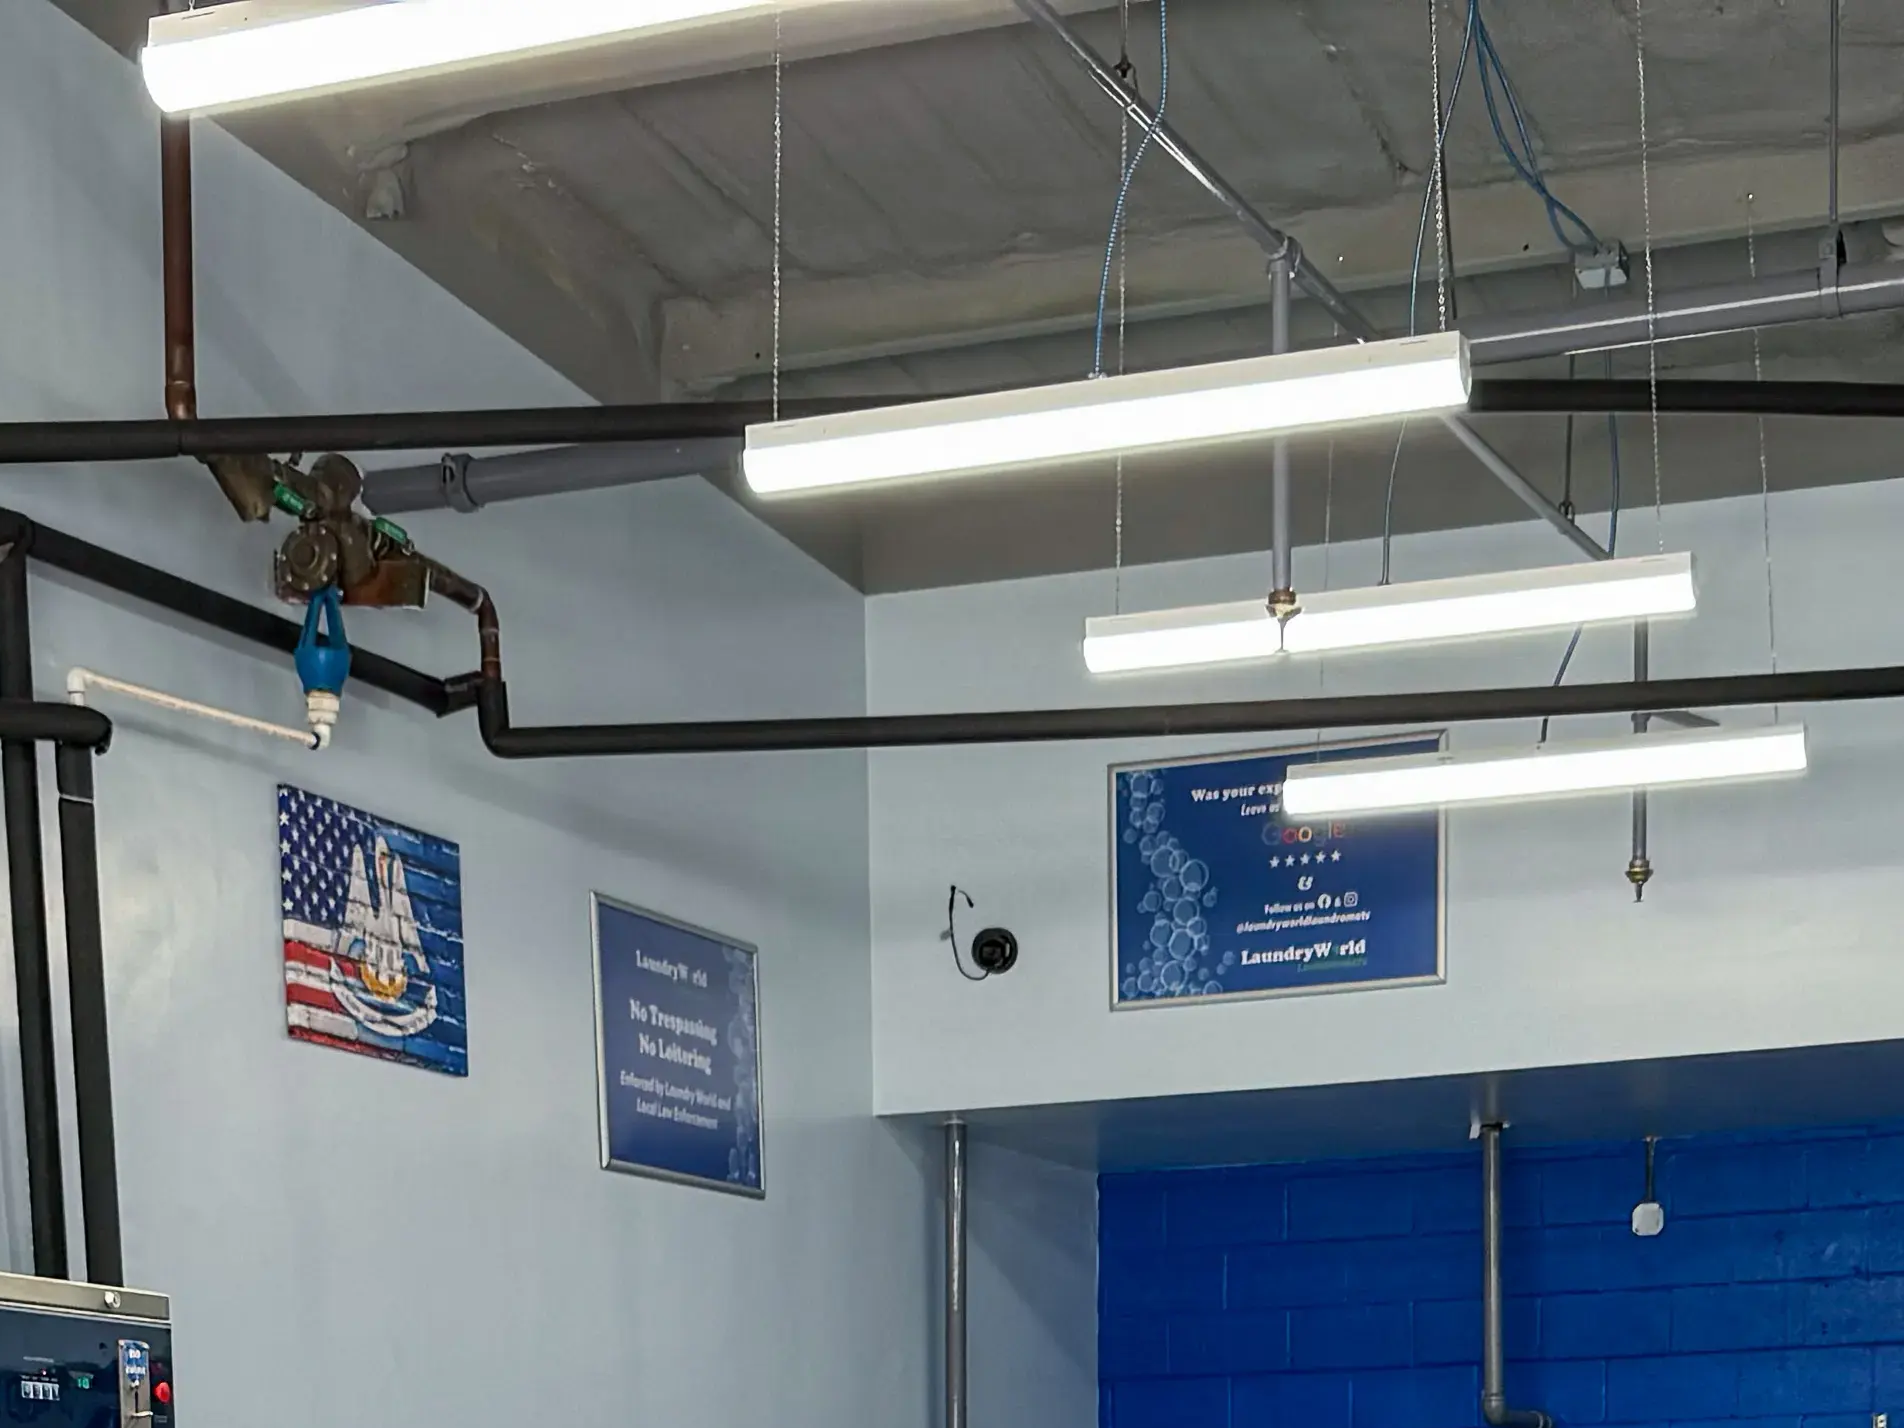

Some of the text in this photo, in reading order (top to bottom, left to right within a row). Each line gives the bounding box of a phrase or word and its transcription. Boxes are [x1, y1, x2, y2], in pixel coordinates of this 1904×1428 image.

[1191, 788, 1220, 802] Was
[1222, 786, 1256, 802] your
[1241, 939, 1366, 965] LaundryWrld
